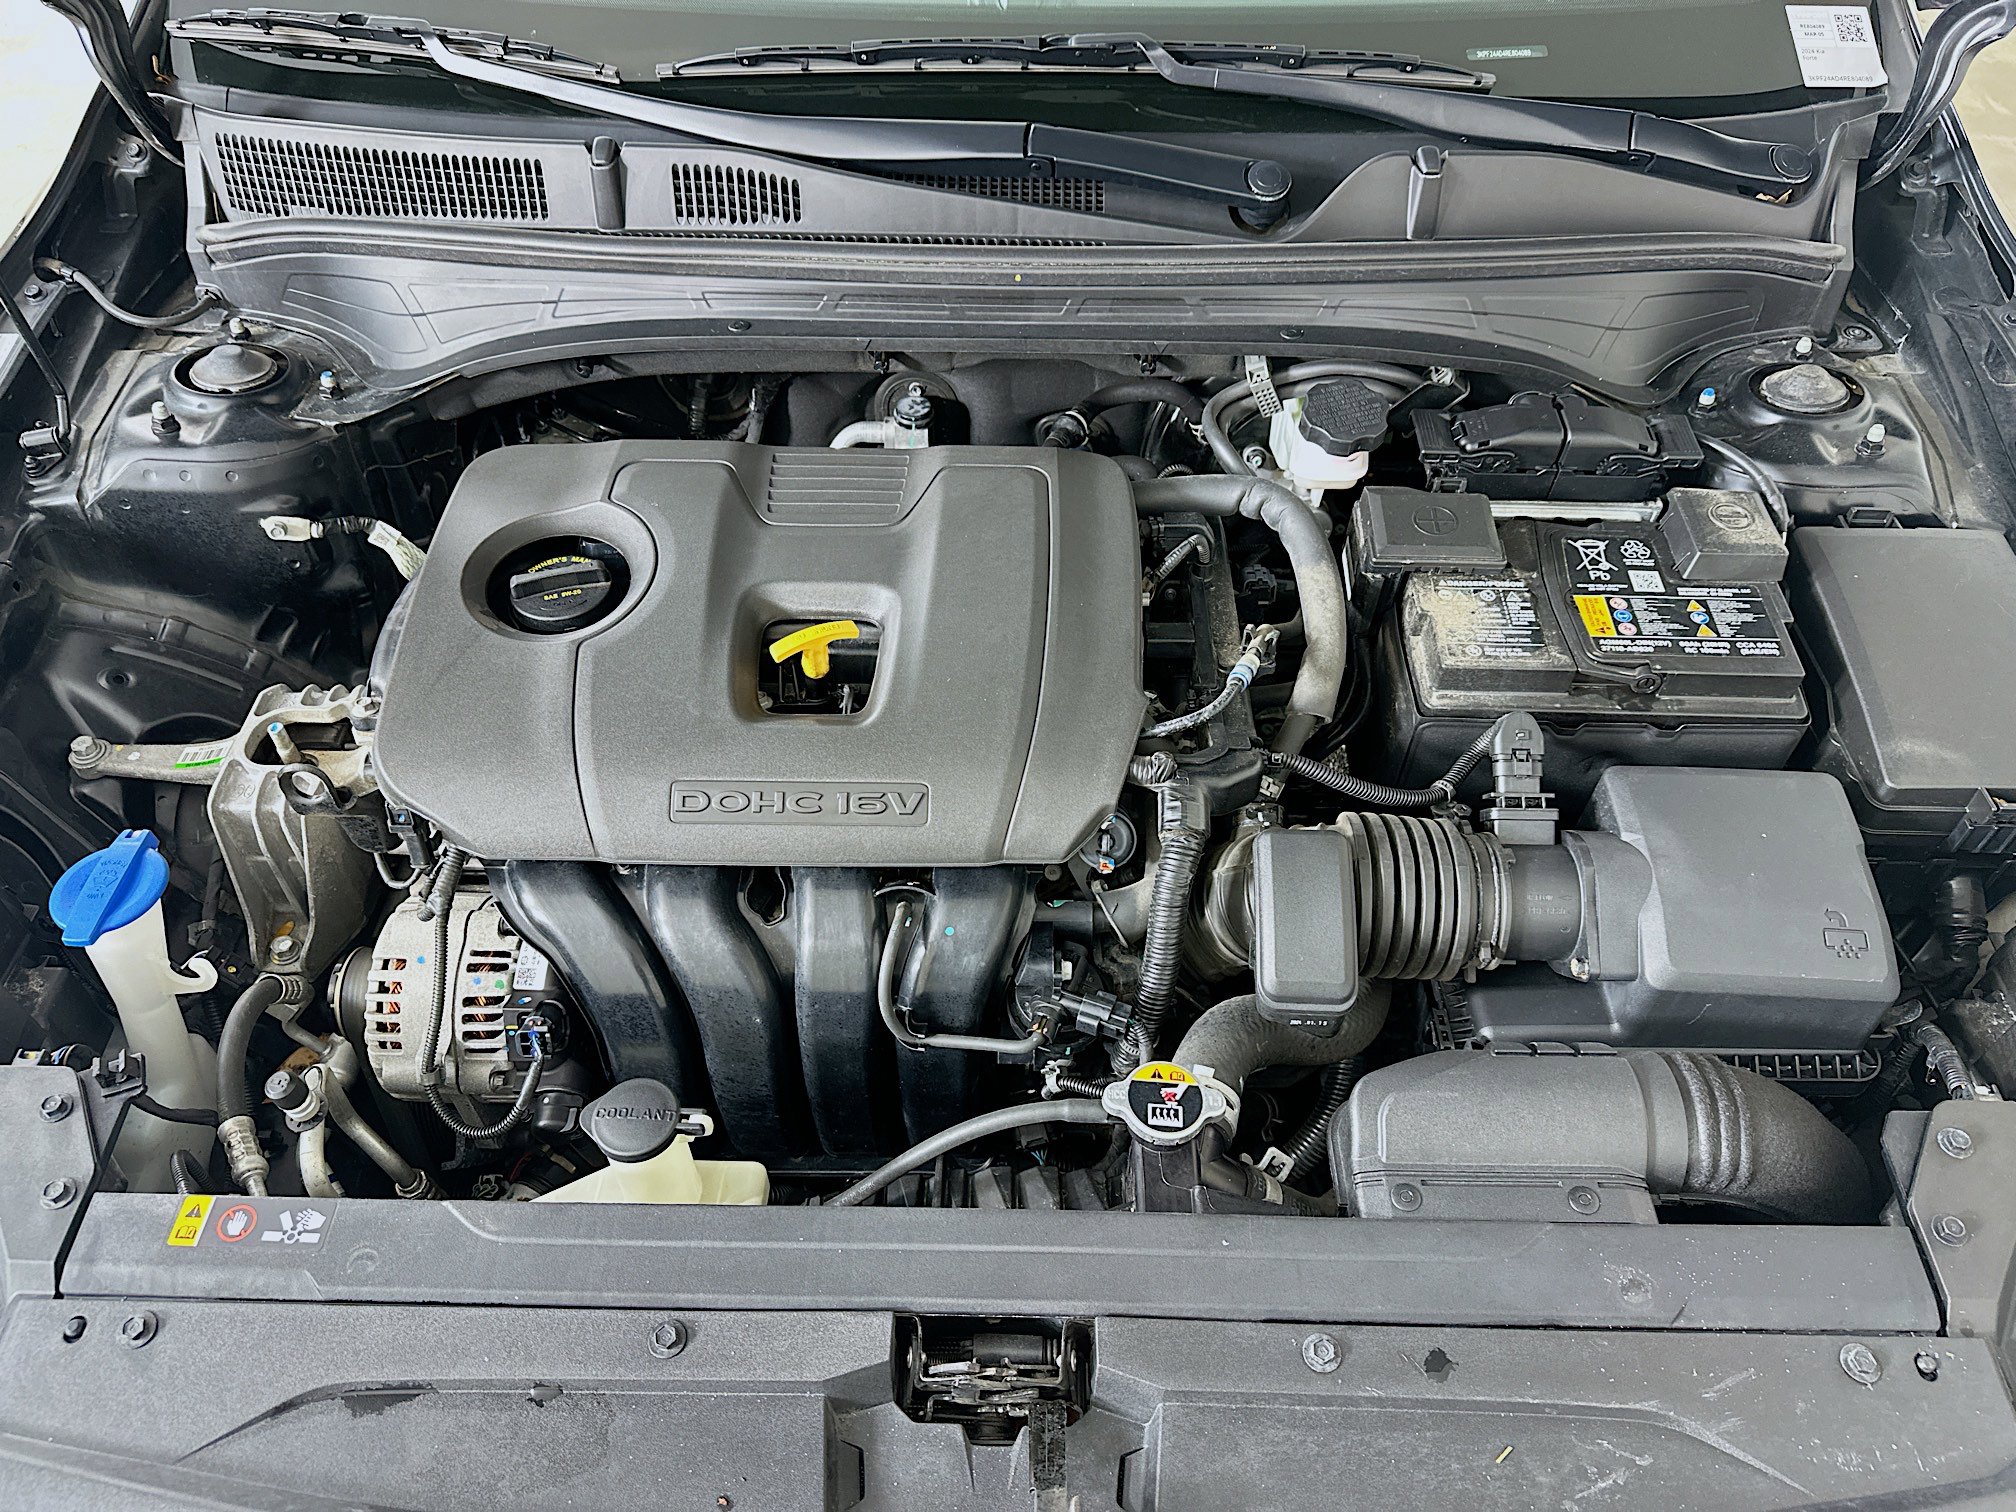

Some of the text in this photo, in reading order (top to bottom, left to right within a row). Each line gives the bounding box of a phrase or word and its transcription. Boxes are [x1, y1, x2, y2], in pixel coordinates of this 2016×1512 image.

[527, 556, 568, 574] OWNER'S
[1588, 570, 1611, 581] Pb
[543, 588, 582, 601] SAE 5W-20
[674, 789, 925, 816] DOHC 16V
[595, 1106, 677, 1122] COOLANT
